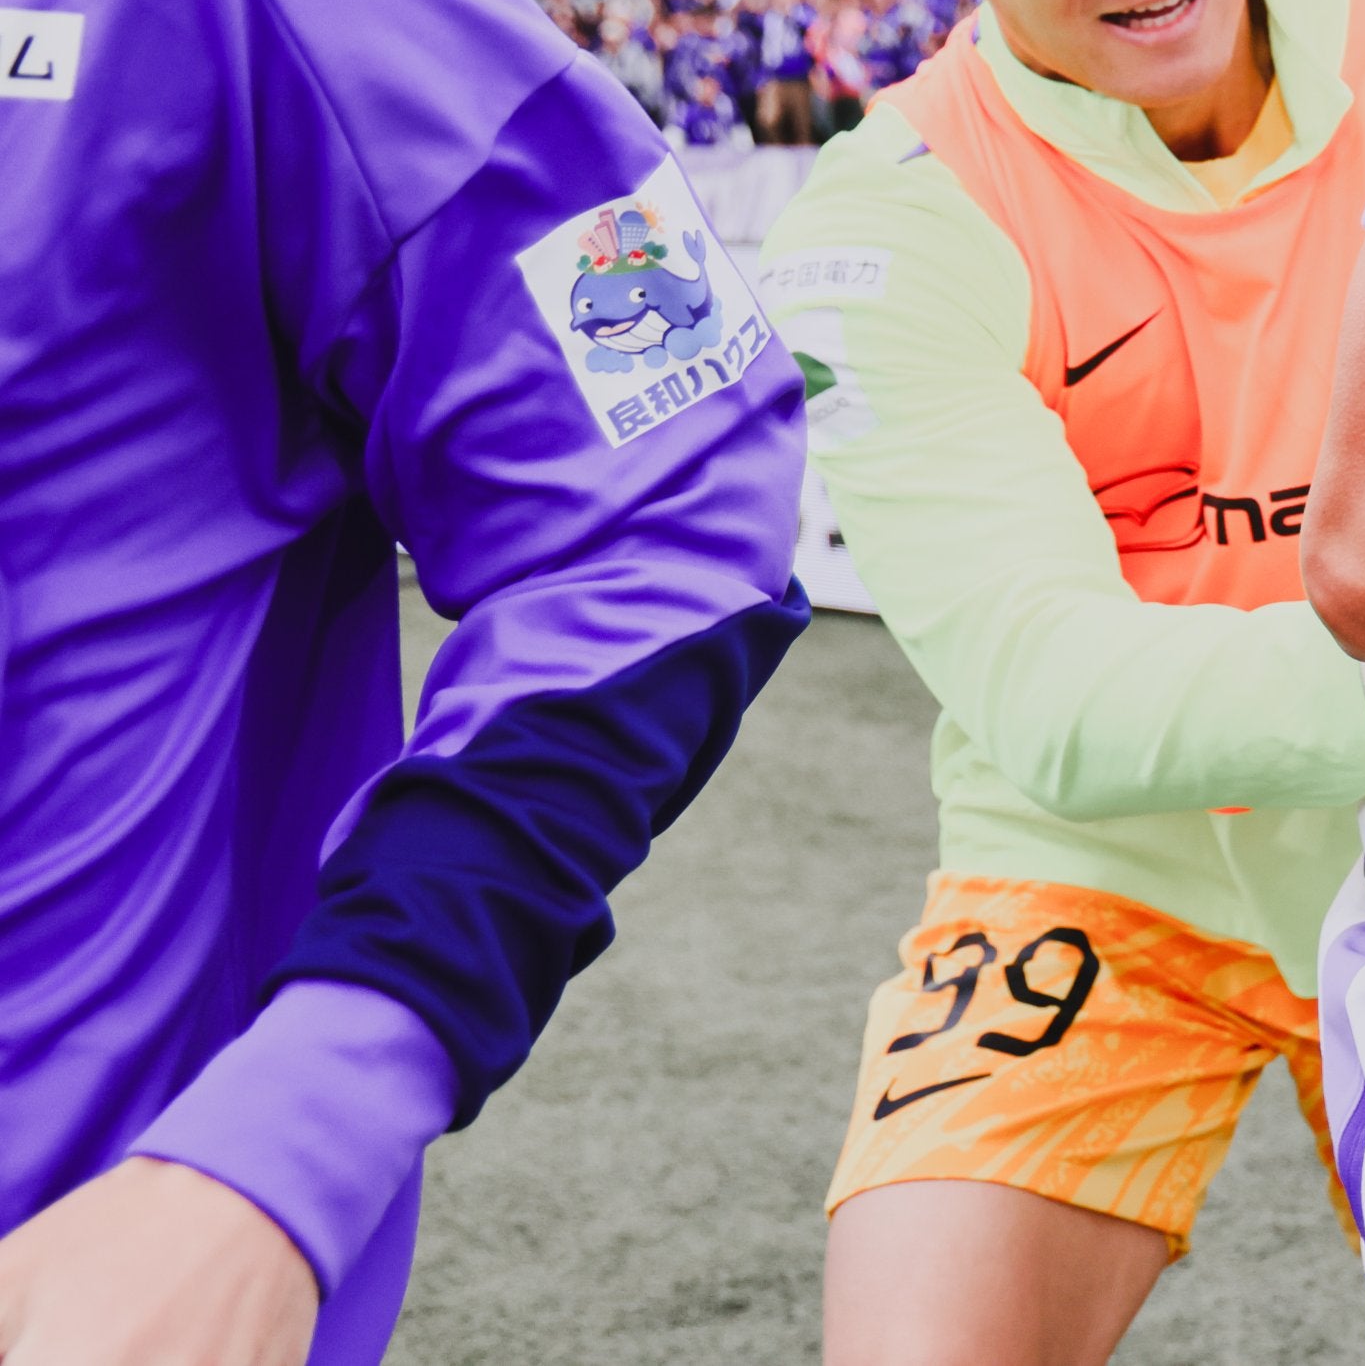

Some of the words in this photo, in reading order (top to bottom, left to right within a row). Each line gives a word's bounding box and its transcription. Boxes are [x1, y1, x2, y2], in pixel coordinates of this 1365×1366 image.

[606, 314, 767, 440] 良和ハウス
[887, 927, 1100, 1056] 99
